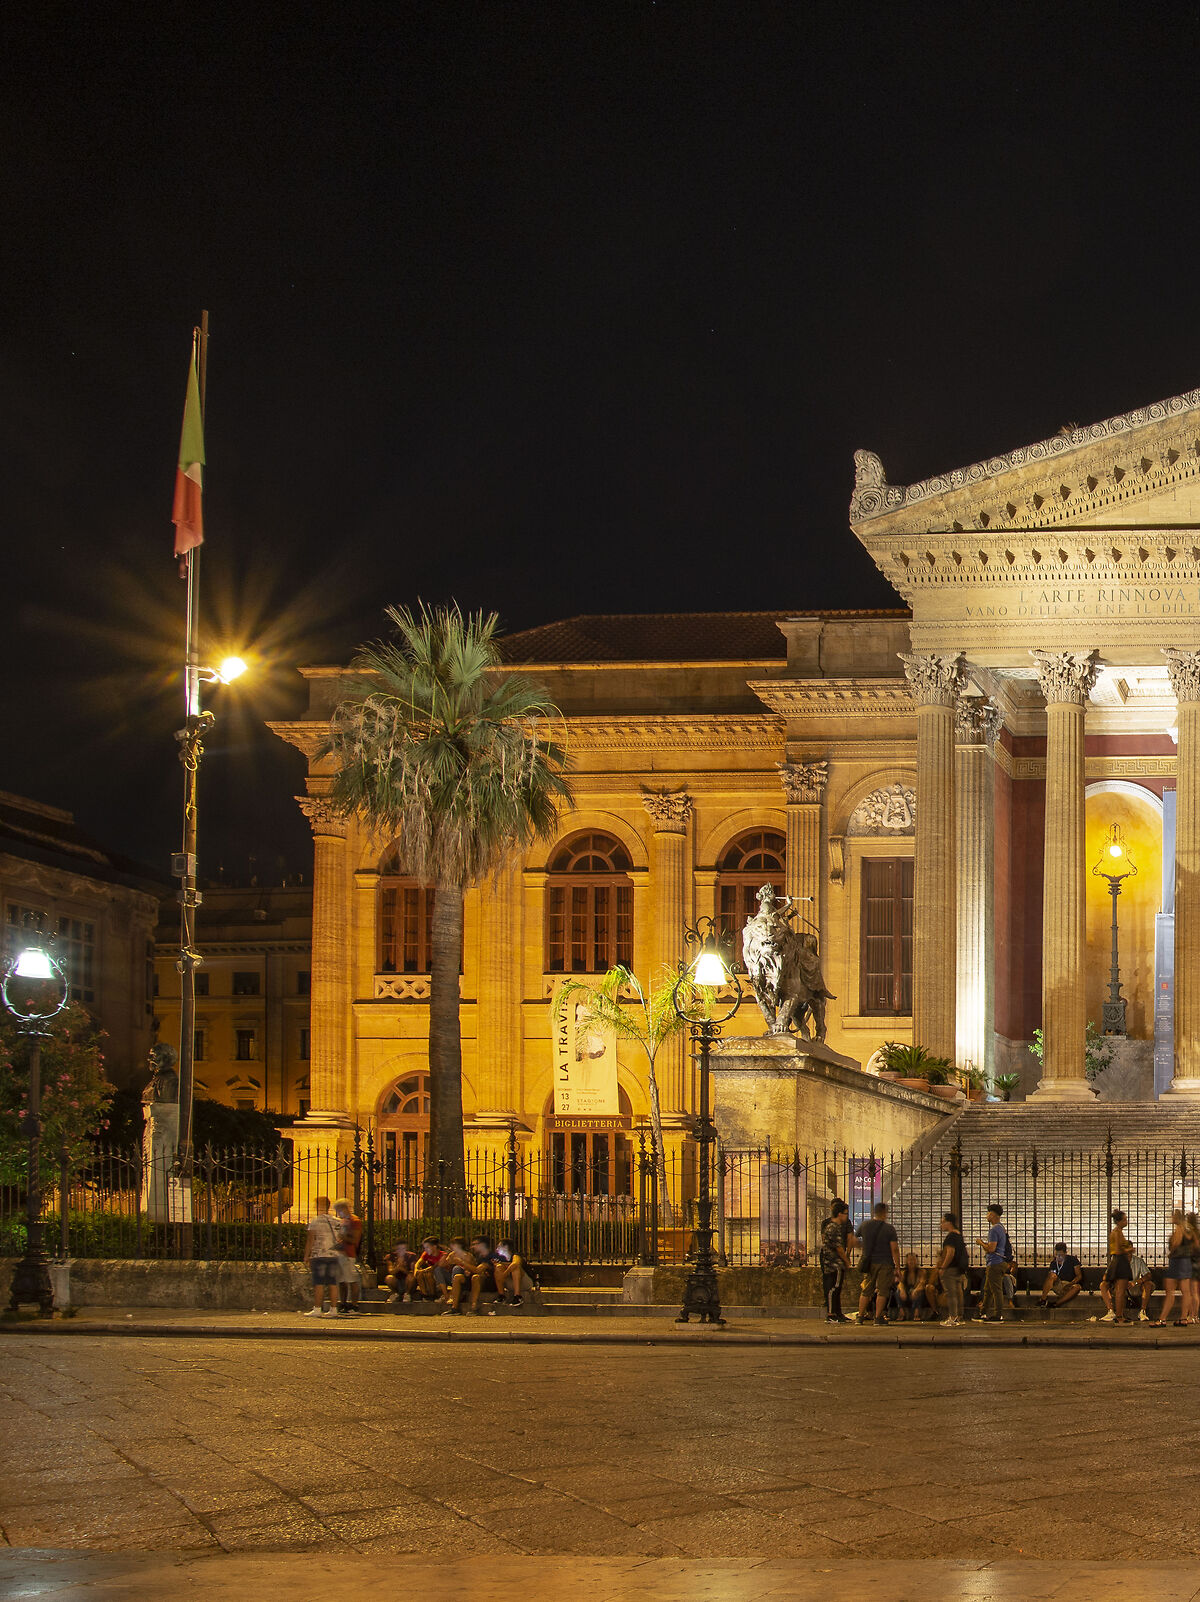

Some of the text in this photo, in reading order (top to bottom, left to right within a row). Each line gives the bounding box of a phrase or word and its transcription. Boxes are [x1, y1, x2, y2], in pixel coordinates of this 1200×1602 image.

[1098, 588, 1186, 602] RINNOVA
[966, 606, 1008, 617] VANO
[1072, 604, 1125, 615] SCENE
[560, 1063, 569, 1081] LA
[561, 1093, 570, 1101] 13
[561, 1104, 570, 1112] 27
[554, 1119, 623, 1128] BIGLIETTERIA
